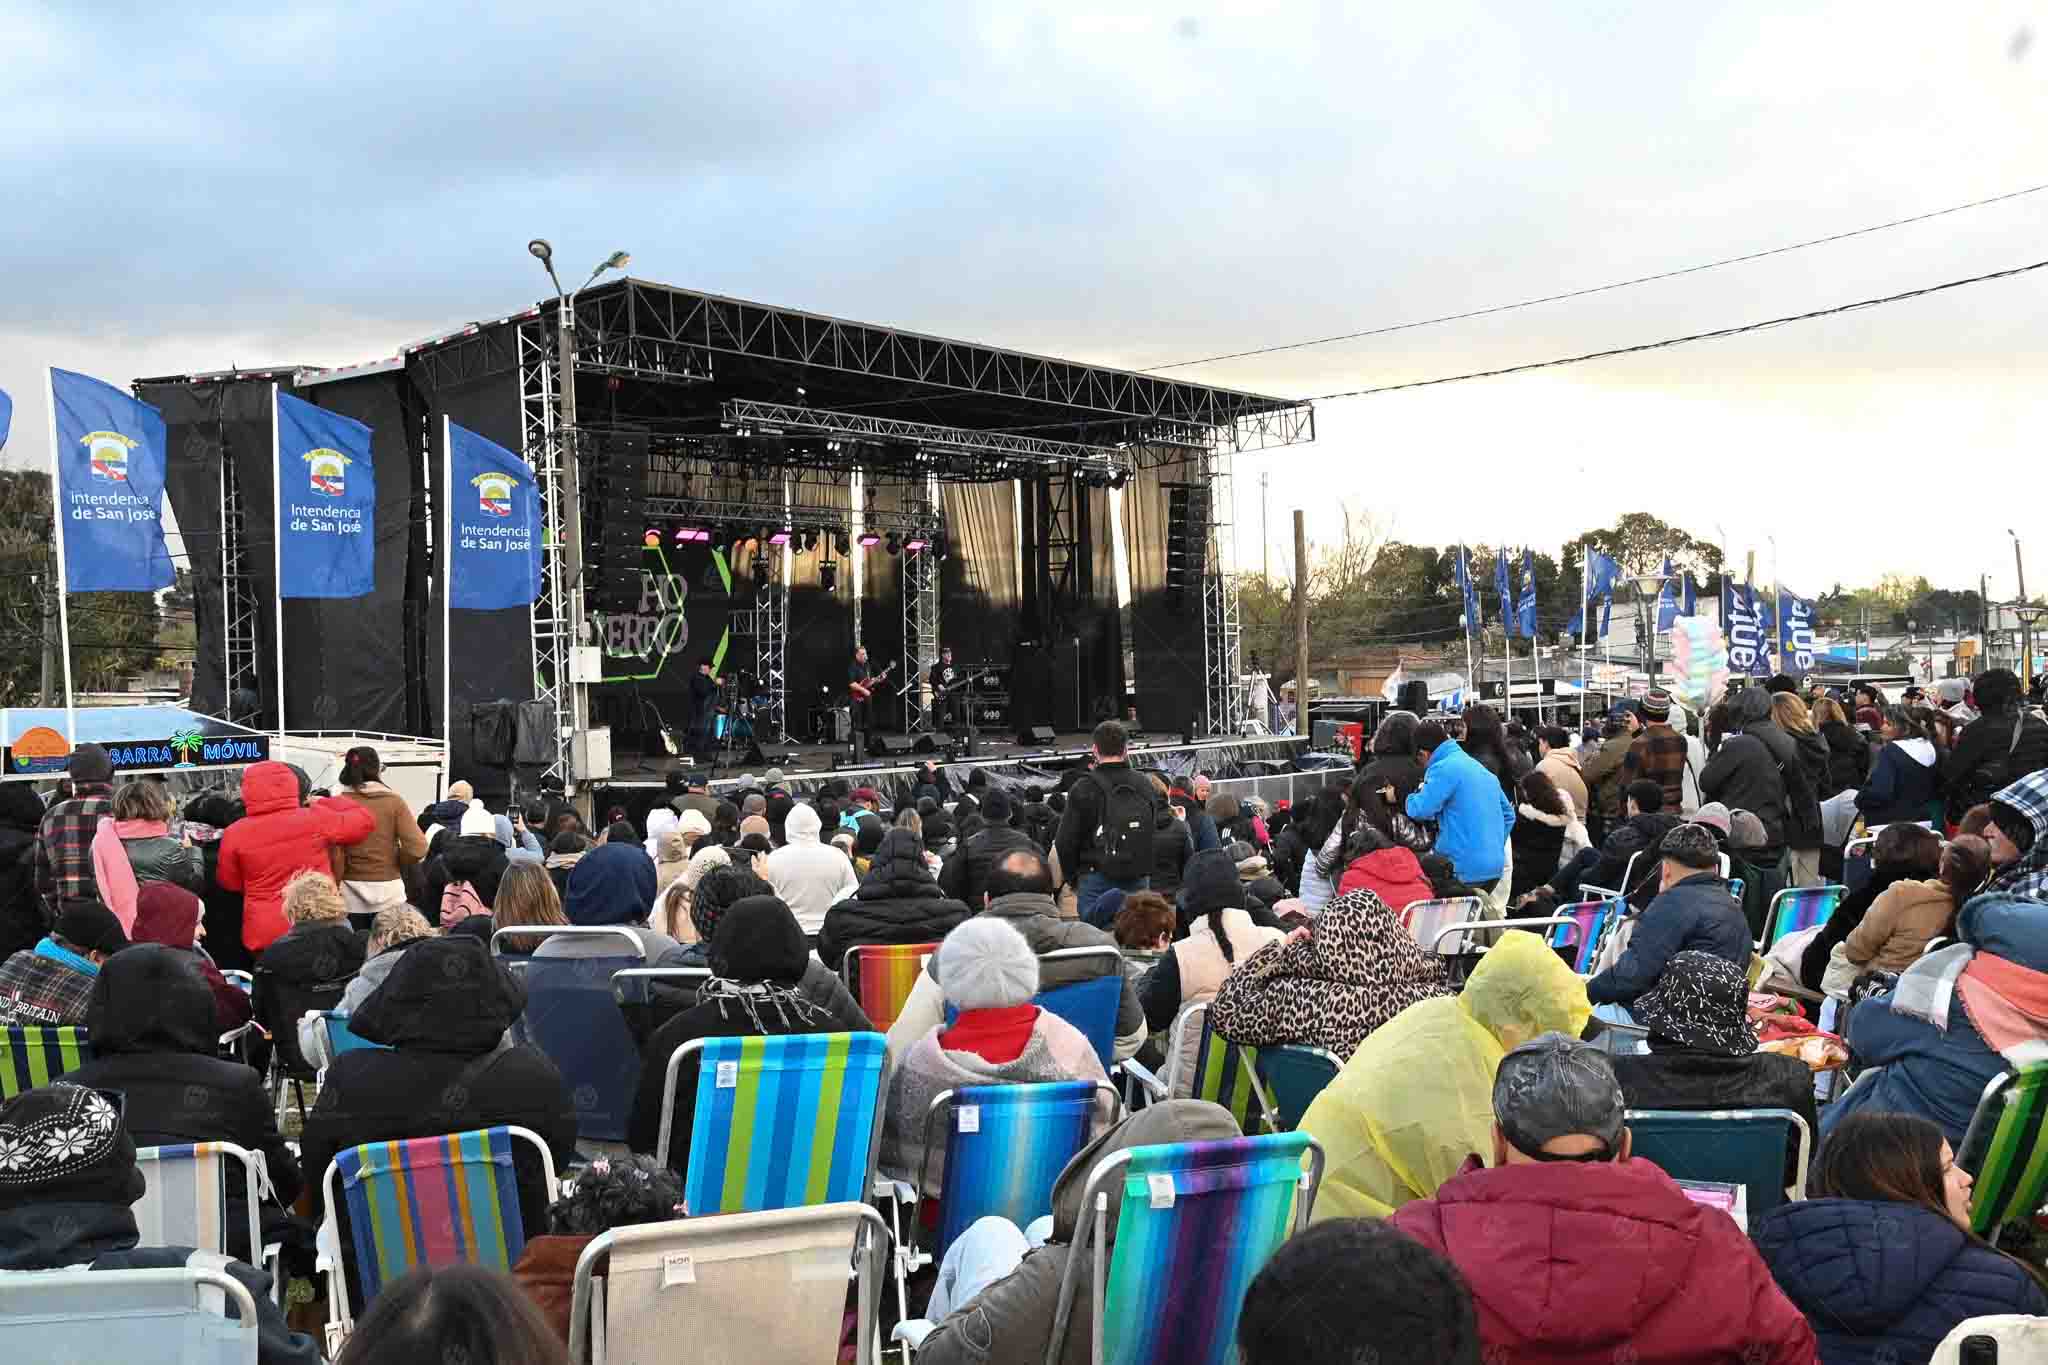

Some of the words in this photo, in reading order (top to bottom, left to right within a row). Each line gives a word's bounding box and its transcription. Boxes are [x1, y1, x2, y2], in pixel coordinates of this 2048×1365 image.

[72, 505, 93, 520] de
[95, 507, 124, 520] San
[290, 517, 308, 531] de
[311, 518, 335, 532] San
[338, 519, 362, 535] José
[461, 521, 531, 537] Intendencia
[461, 535, 477, 549] de
[479, 537, 503, 550] San
[505, 538, 531, 552] José
[111, 746, 172, 765] BARRA
[203, 739, 262, 760] MÓVIL
[14, 1001, 61, 1024] BRITAIN
